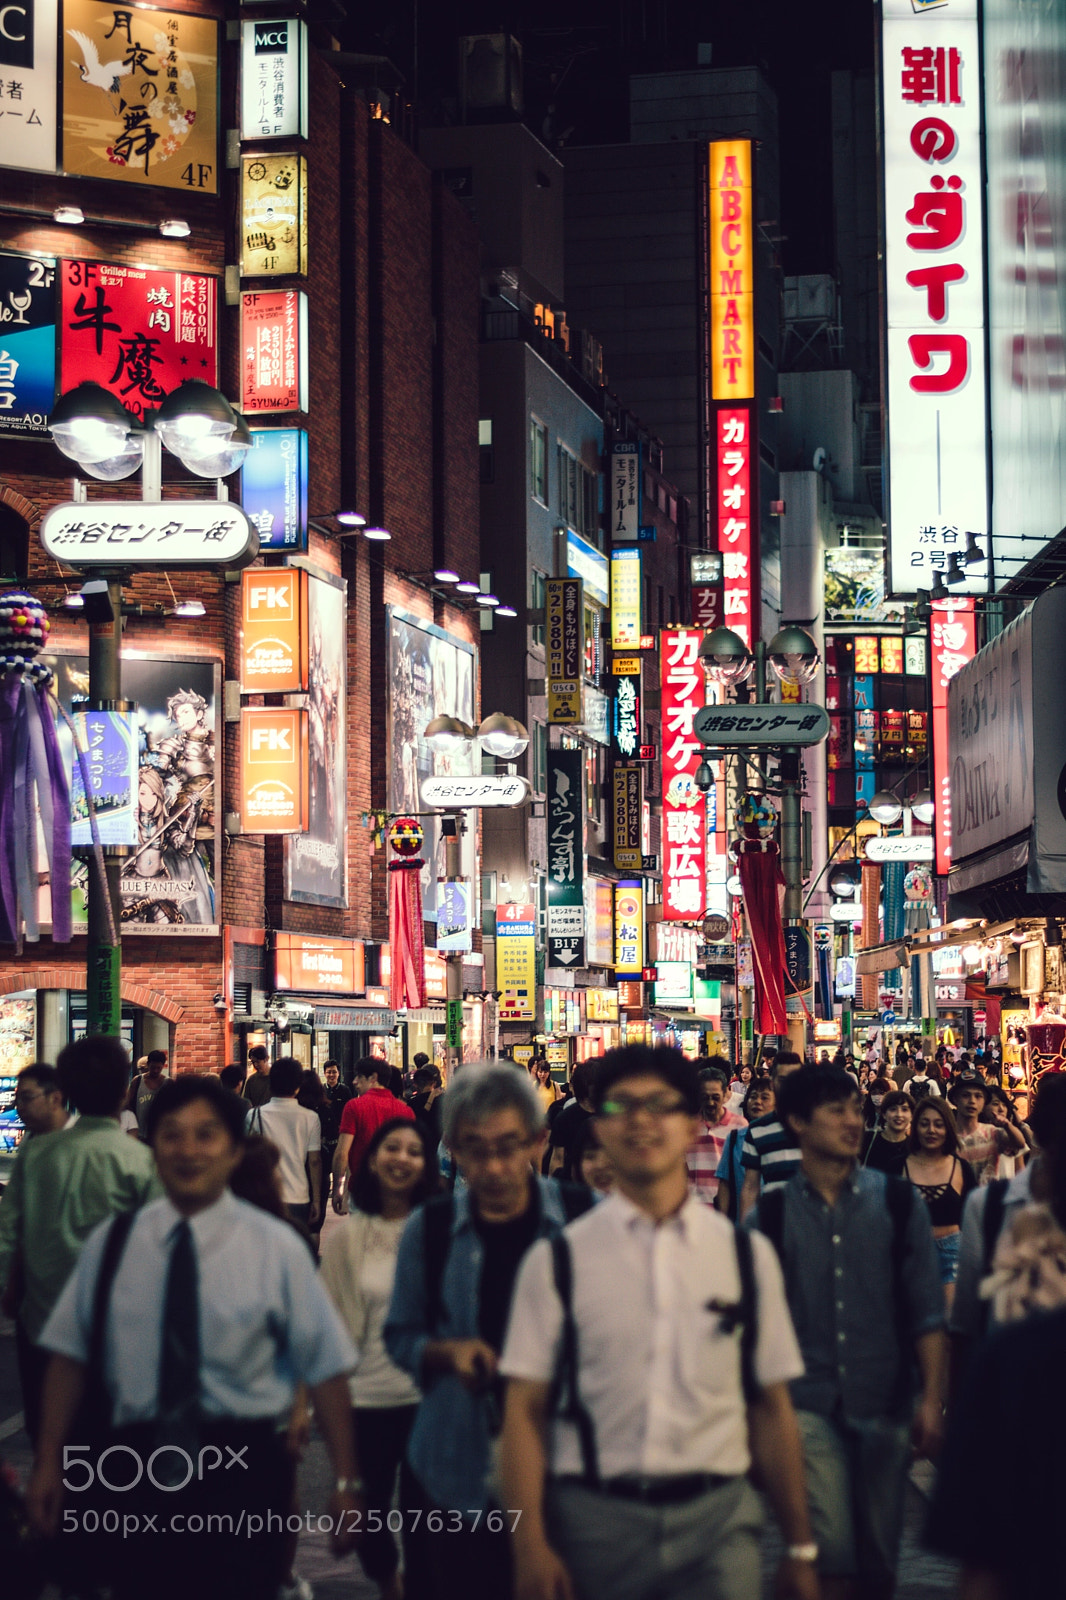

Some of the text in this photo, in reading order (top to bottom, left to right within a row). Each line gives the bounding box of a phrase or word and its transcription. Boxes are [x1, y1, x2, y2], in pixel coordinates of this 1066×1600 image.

[254, 31, 288, 47] MCC
[166, 18, 179, 96] 個室居酒屋
[105, 10, 160, 177] 月夜の舞
[258, 62, 269, 123] モニタールーム
[272, 57, 285, 119] 渋谷消費者
[261, 125, 283, 135] 5F
[180, 162, 212, 188] 4F
[901, 46, 967, 394] 靴のダイワ
[68, 262, 97, 288] 3F
[101, 266, 147, 280] Grilled meat
[261, 256, 279, 270] 4F
[719, 155, 743, 385] ABC-MART
[181, 277, 196, 344] 食べ放題
[244, 294, 260, 306] 3F
[53, 520, 236, 544] 渋谷センター街
[919, 526, 958, 543] 渋谷
[250, 586, 290, 609] FK
[565, 585, 577, 676] 全身もみほぐし
[641, 639, 653, 648] 4F
[700, 714, 822, 732] 渋谷センター街
[252, 728, 291, 750] FK
[90, 721, 106, 790] 七夕まつり
[628, 774, 638, 847] 全身もみほぐし
[643, 858, 655, 868] 2F
[505, 905, 525, 920] 4F
[554, 939, 579, 949] B1F
[619, 924, 638, 963] 松屋
[788, 934, 798, 977] 七夕まつり
